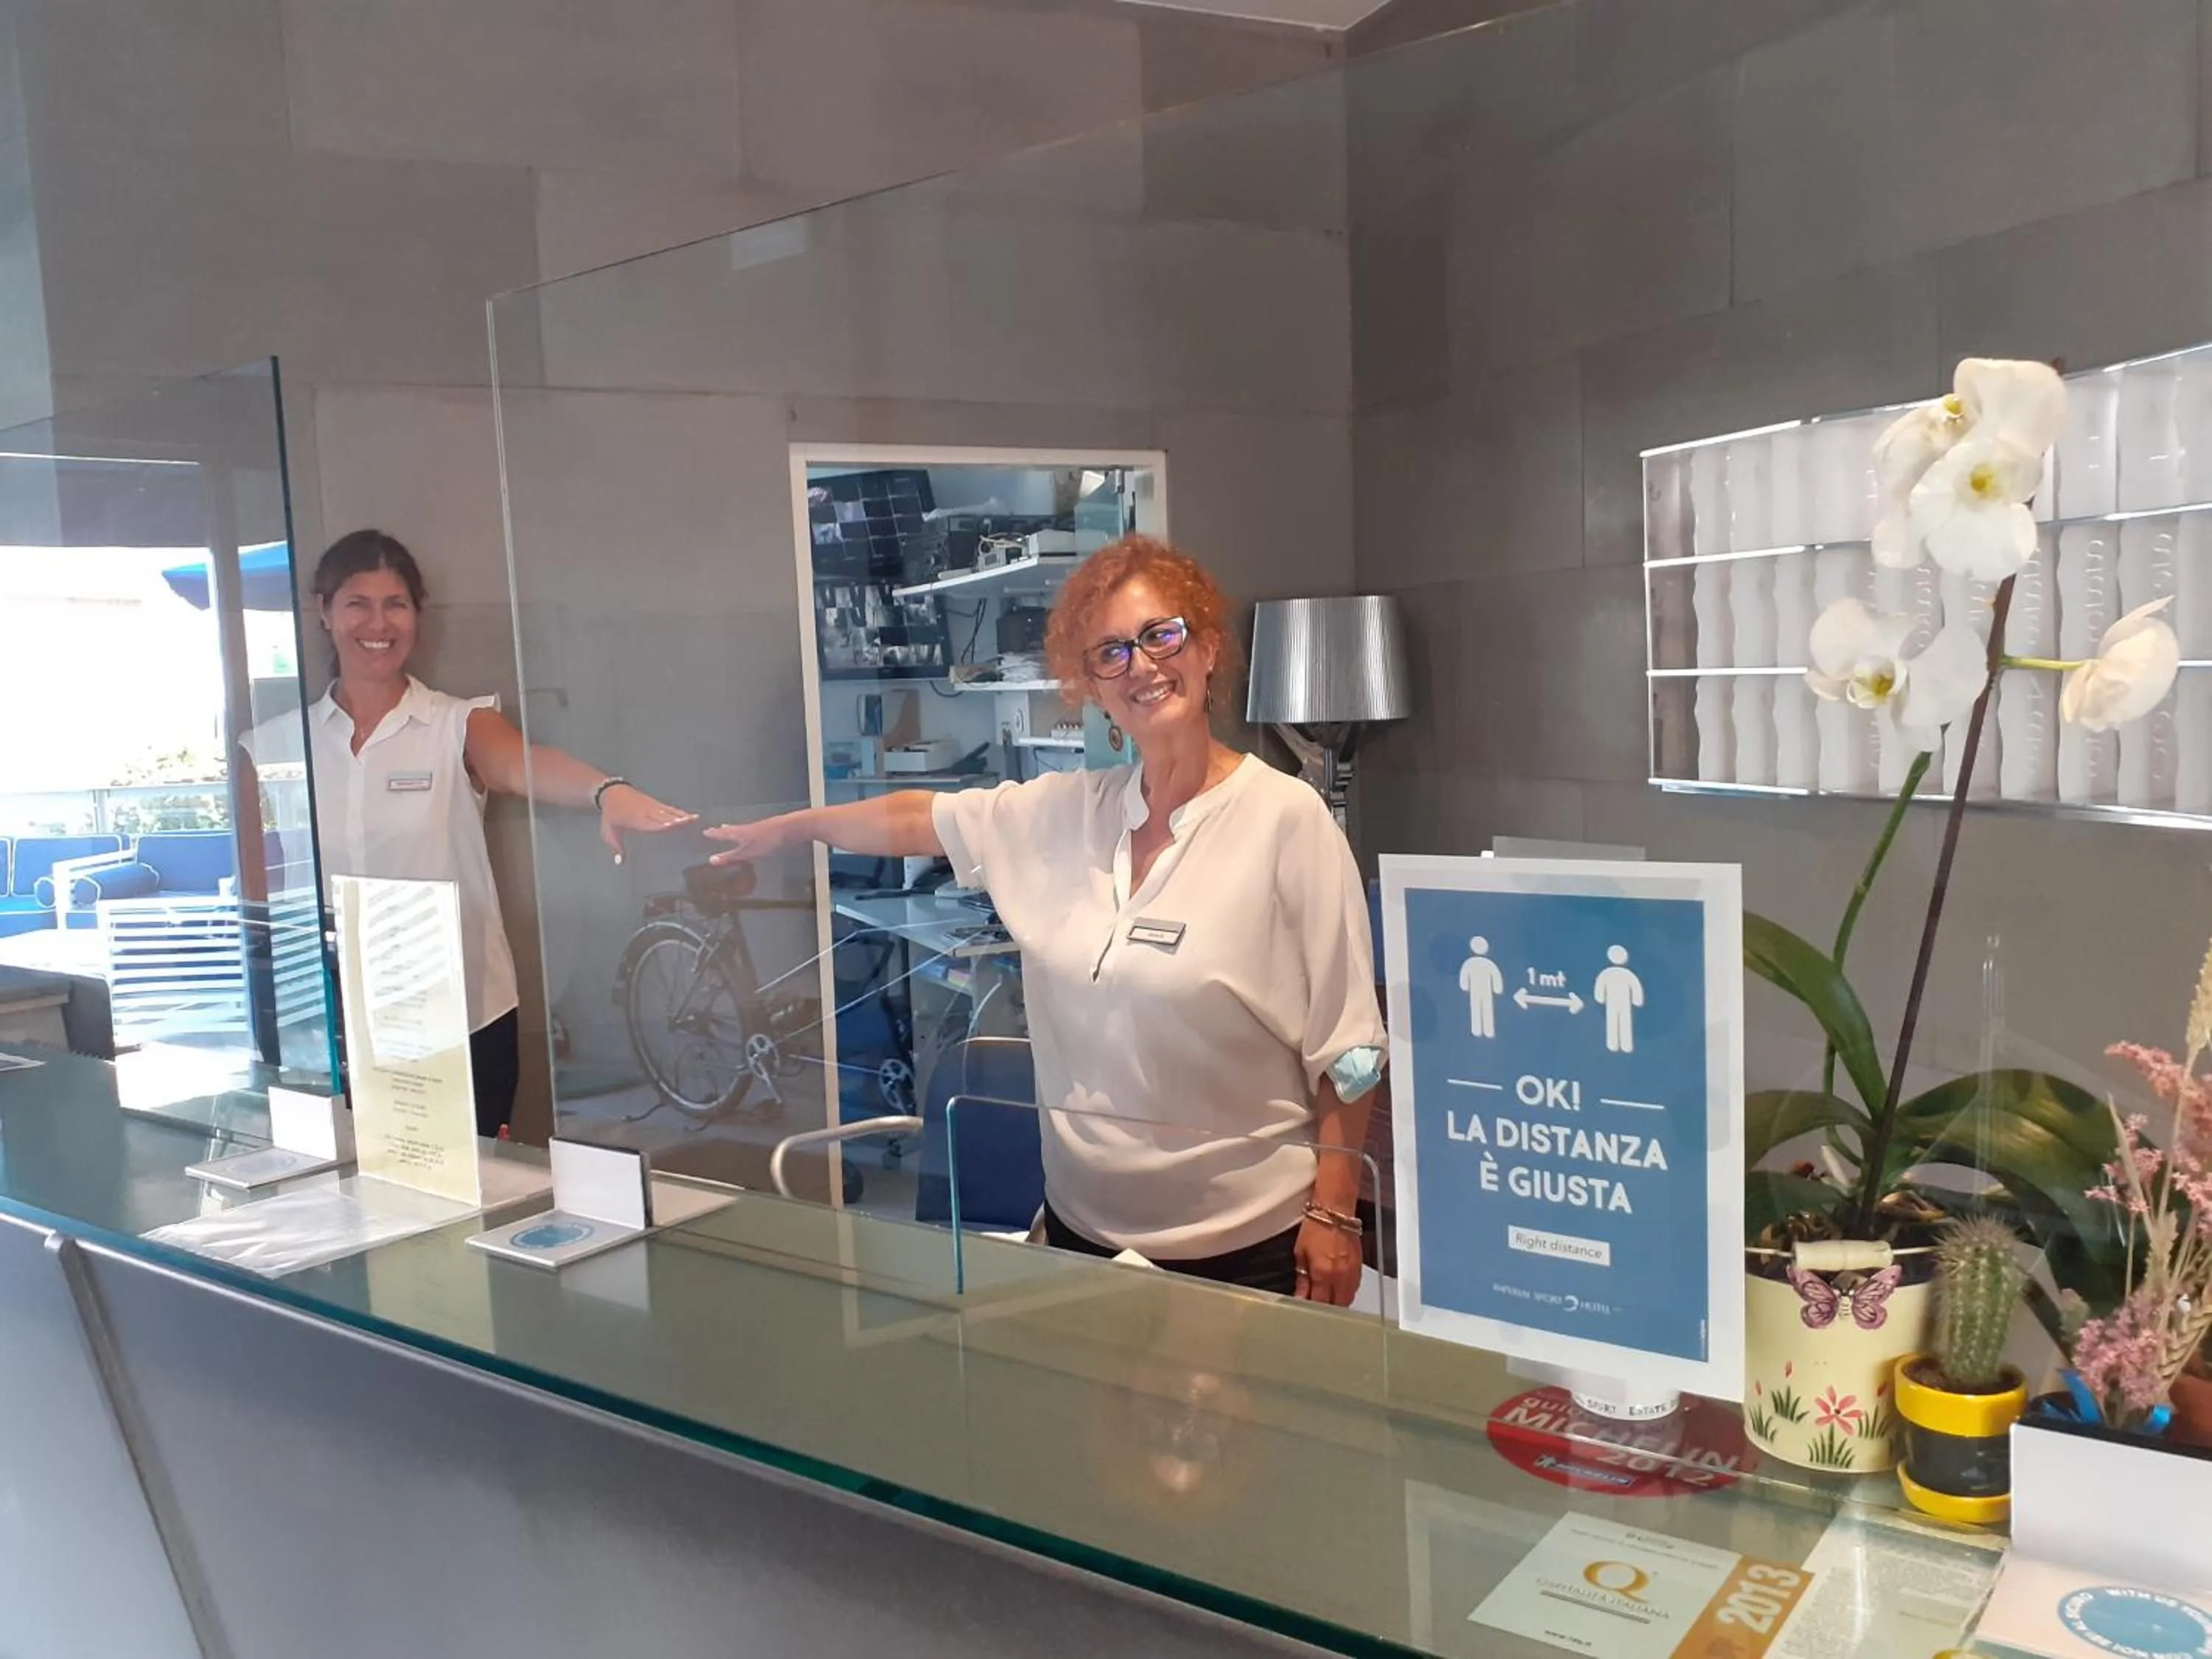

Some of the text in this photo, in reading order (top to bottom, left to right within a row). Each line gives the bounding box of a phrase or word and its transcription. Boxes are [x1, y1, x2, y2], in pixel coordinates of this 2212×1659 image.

[1527, 967, 1566, 988] 1 mt
[1515, 1074, 1581, 1111] OK!
[1447, 1110, 1669, 1172] LA DISTANZA
[1480, 1151, 1633, 1215] È GIUSTA
[1514, 1231, 1603, 1259] Right distance
[1596, 1449, 1715, 1487] 2012
[1715, 1563, 1801, 1635] 2013
